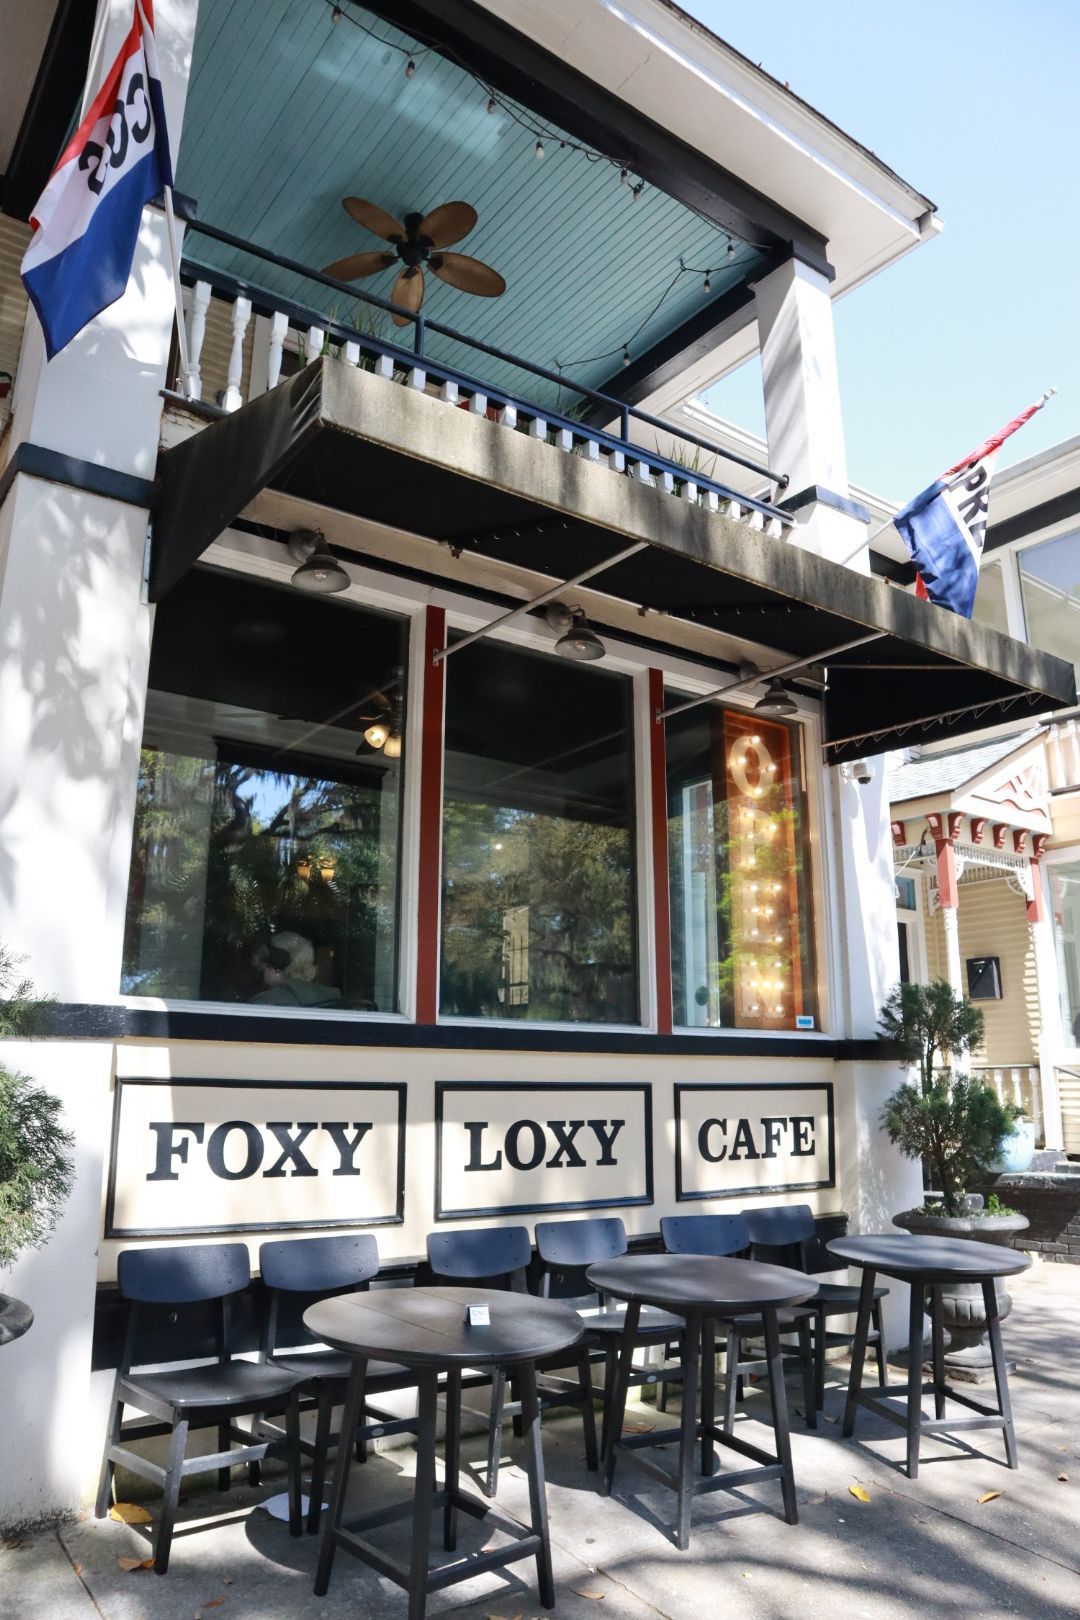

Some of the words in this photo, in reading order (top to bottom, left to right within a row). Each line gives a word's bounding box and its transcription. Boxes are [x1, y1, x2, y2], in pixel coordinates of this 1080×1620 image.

[729, 735, 785, 1018] OPEN
[146, 1120, 373, 1181] FOXY
[464, 1119, 625, 1172] LOXY
[698, 1116, 815, 1163] CAFE
